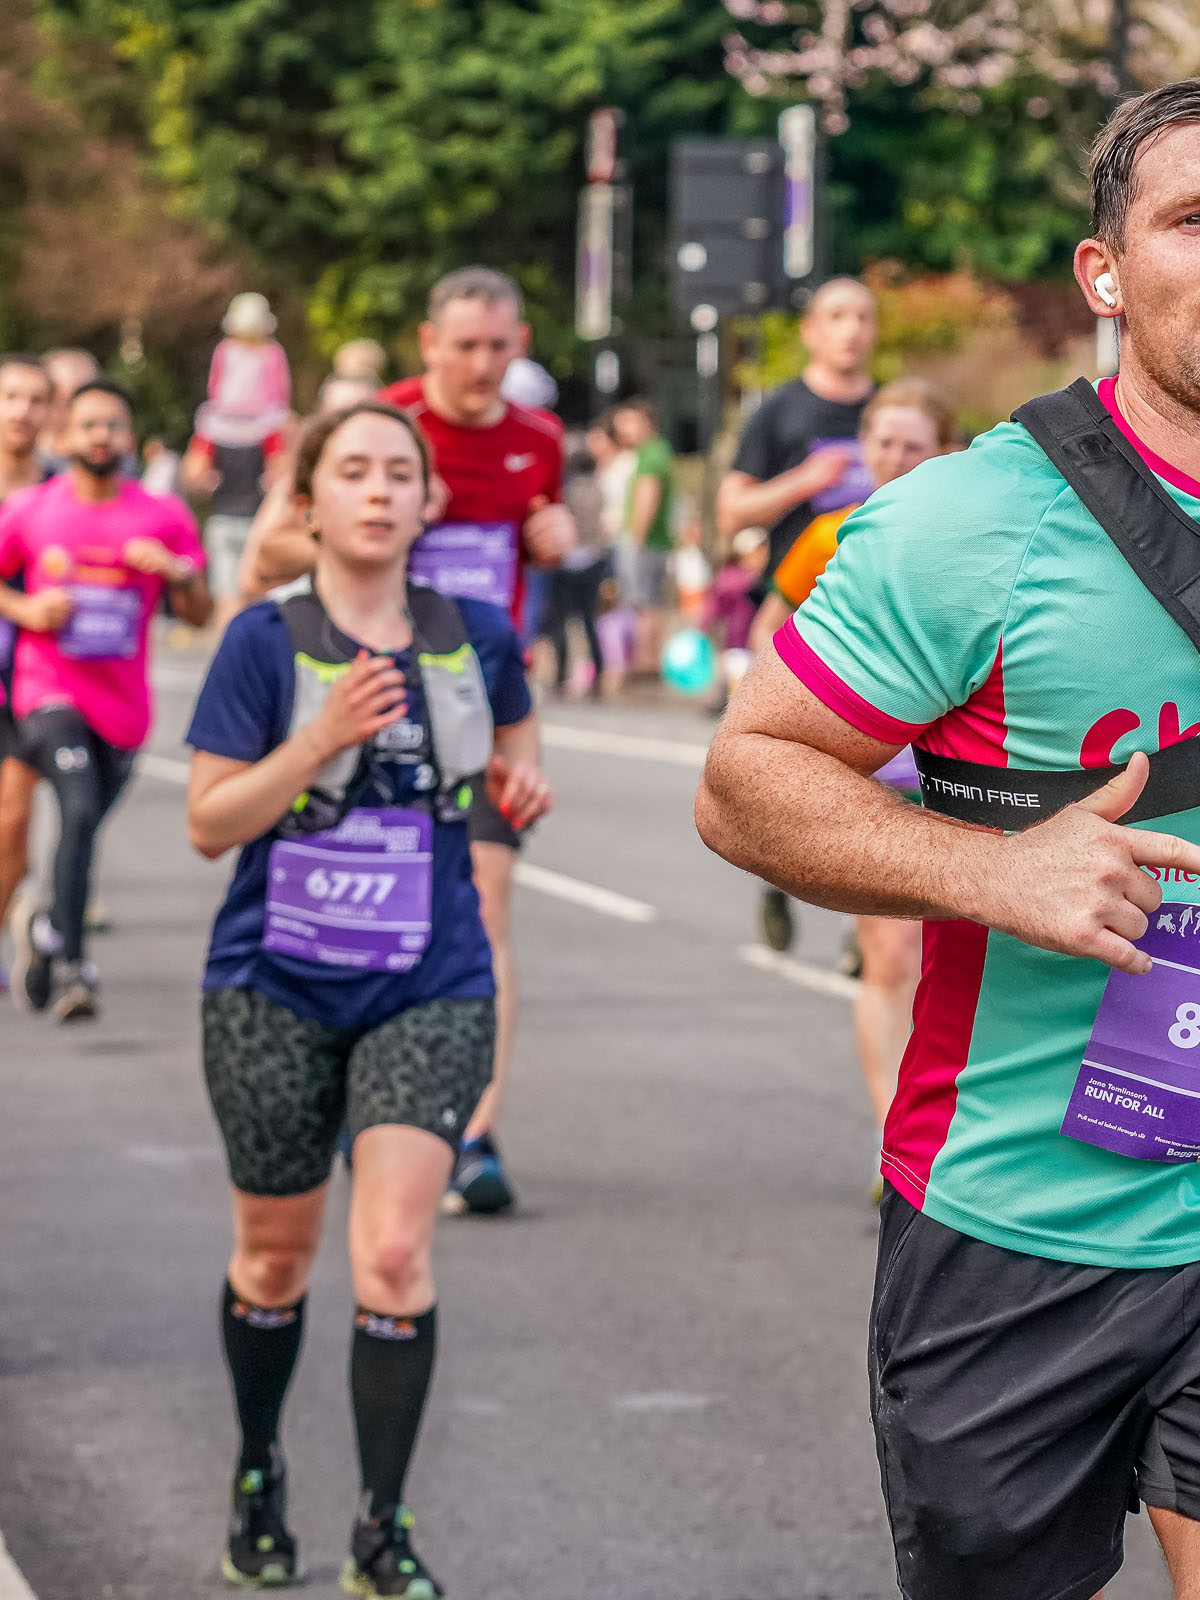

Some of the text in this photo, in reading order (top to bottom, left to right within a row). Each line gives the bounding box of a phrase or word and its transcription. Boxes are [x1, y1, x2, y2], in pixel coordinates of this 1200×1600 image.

[930, 776, 984, 802] TRAIN
[986, 788, 1041, 808] FREE
[304, 867, 398, 905] 6777
[1084, 1085, 1165, 1120] RUN FOR ALL
[1088, 1077, 1149, 1102] Jane Tomlinson's
[1077, 1113, 1088, 1121] Pull
[1103, 1121, 1118, 1131] label
[1117, 1126, 1138, 1137] through
[1154, 1135, 1172, 1145] Please
